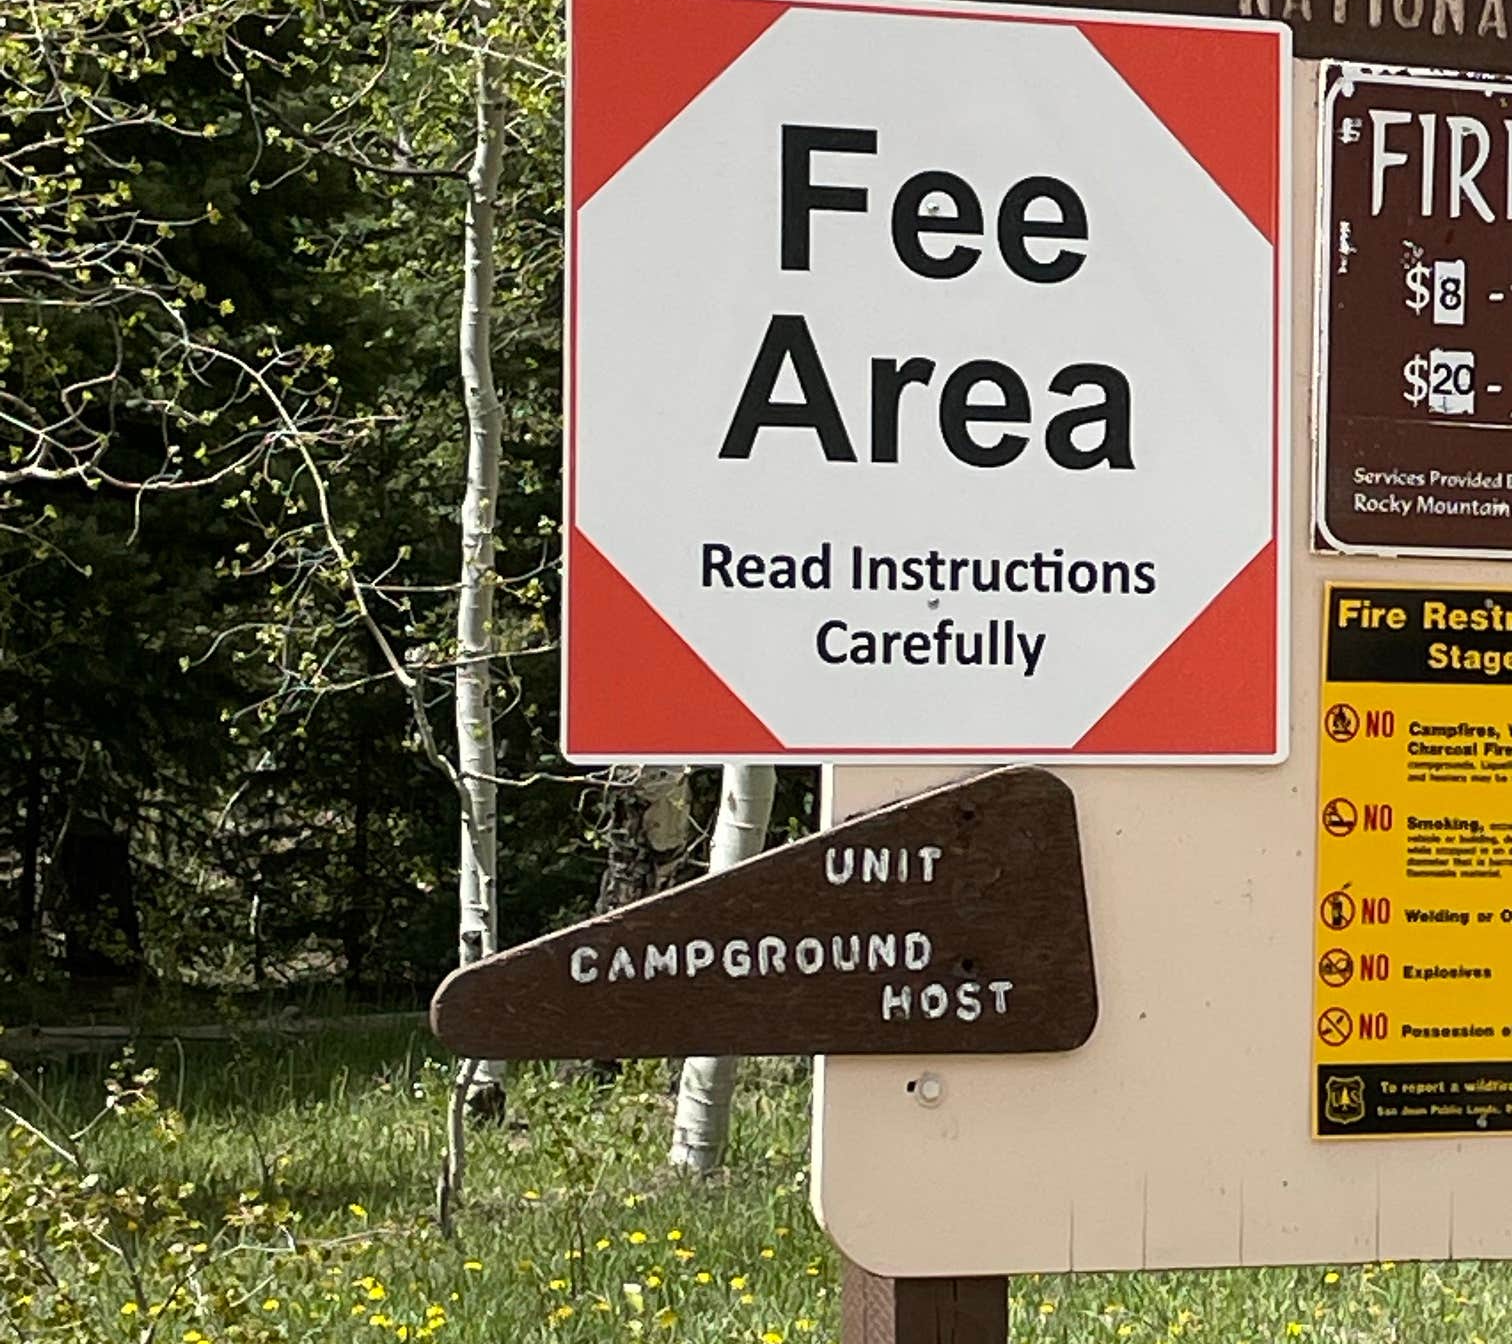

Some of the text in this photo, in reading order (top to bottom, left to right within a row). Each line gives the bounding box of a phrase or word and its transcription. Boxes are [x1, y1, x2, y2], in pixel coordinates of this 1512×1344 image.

[780, 124, 1090, 284] Fee
[1405, 261, 1461, 315] $8
[717, 313, 1136, 472] Area
[1403, 354, 1474, 407] $20
[1353, 467, 1425, 487] Services
[1430, 471, 1502, 489] Provided
[1353, 493, 1412, 516] Rocky
[1416, 496, 1510, 517] Mountain
[700, 543, 1156, 595] Read Instructions
[1338, 599, 1407, 629] Fire
[815, 620, 1046, 676] Carefully
[1366, 709, 1395, 738] NO
[1409, 721, 1501, 739] Campfires,
[1408, 741, 1477, 756] Charcoal
[1364, 804, 1393, 831] NO
[1407, 816, 1485, 834] Smoking,
[824, 846, 942, 886] UNIT
[1361, 897, 1391, 925] NO
[1405, 908, 1470, 926] Welding
[1476, 911, 1494, 924] or
[569, 931, 932, 983] CAMPGROUND
[1360, 954, 1492, 981] NO Explosives
[881, 980, 1013, 1022] HOST
[1359, 1012, 1388, 1040] NO
[1401, 1024, 1495, 1038] Possession
[1380, 1081, 1398, 1094] To
[1402, 1080, 1445, 1095] report
[1450, 1082, 1460, 1093] a
